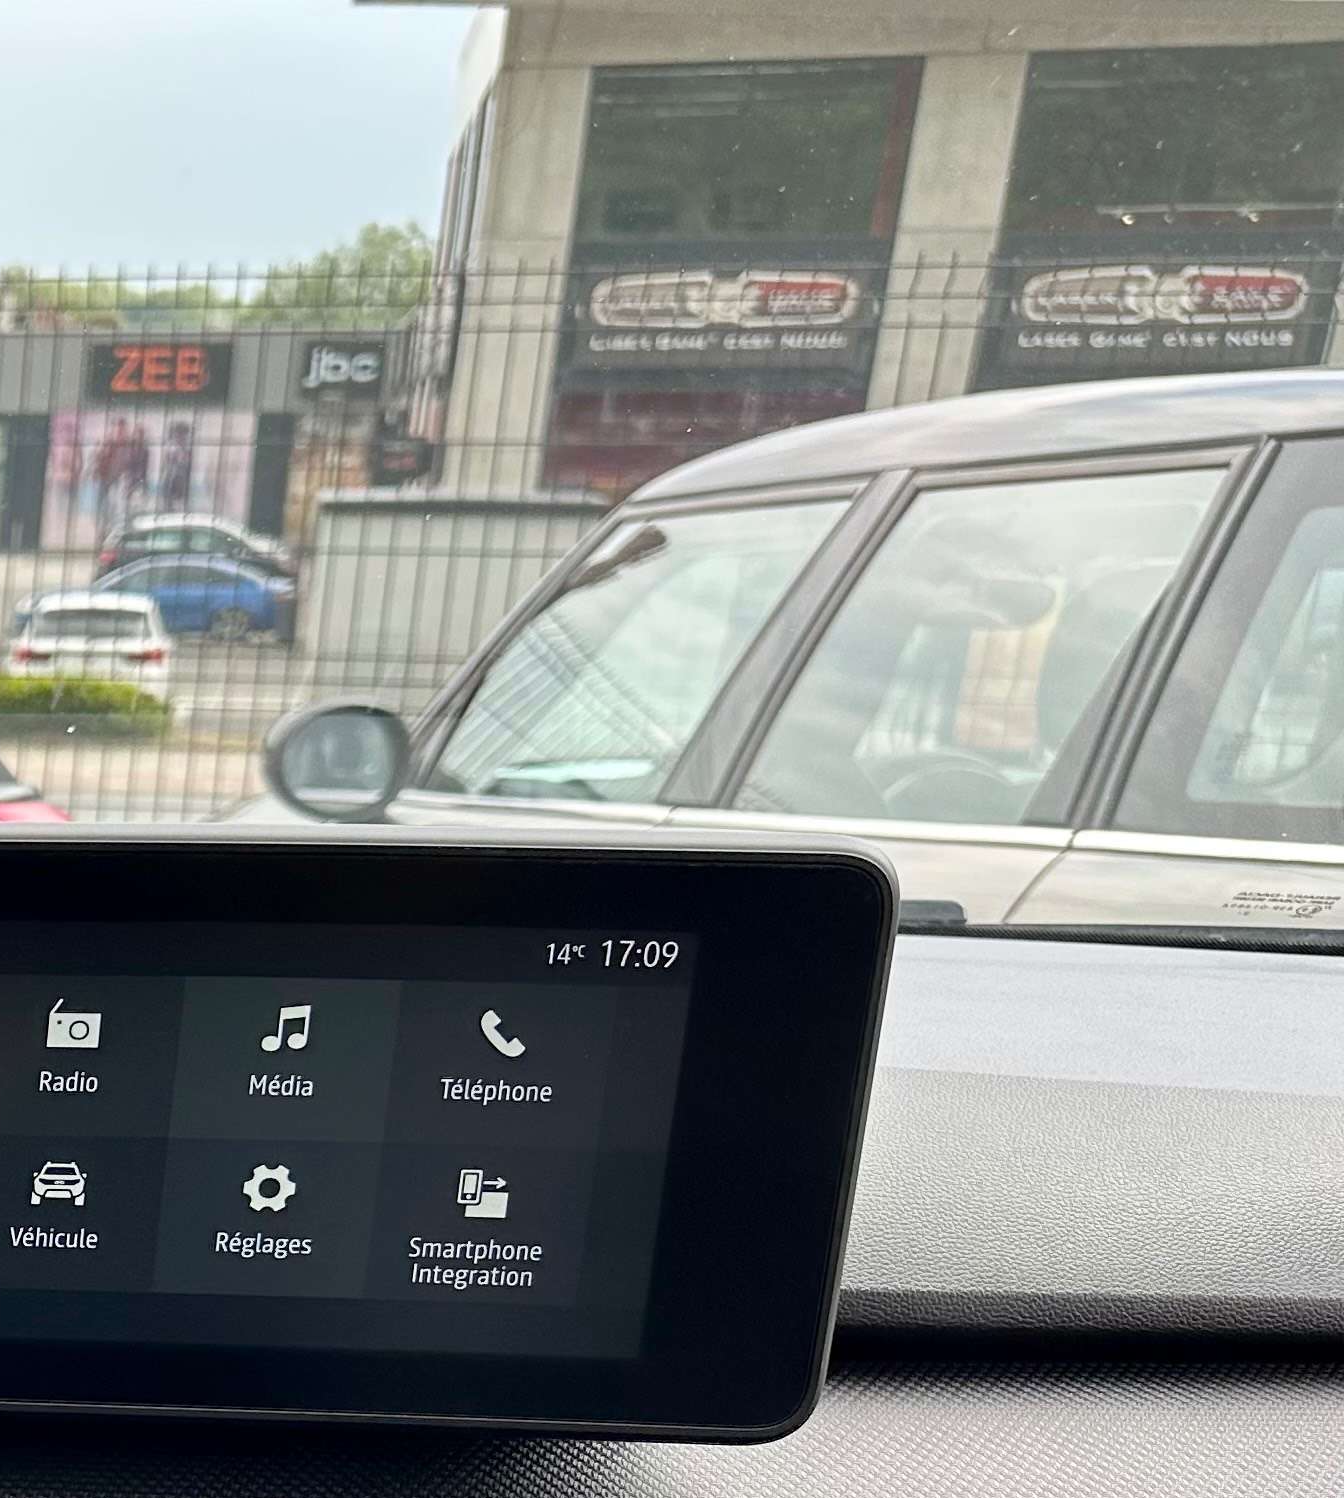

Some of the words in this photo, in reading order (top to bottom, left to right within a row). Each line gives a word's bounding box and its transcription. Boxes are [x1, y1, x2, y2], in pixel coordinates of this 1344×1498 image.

[111, 344, 204, 391] ZEB
[602, 939, 680, 968] 17:09
[39, 1070, 99, 1093] Radio
[248, 1074, 314, 1097] Média
[440, 1078, 553, 1106] Téléphone
[9, 1226, 98, 1249] Véhicule
[214, 1231, 313, 1259] Réglages
[408, 1237, 543, 1264] Smartphone
[411, 1262, 533, 1290] Integration
